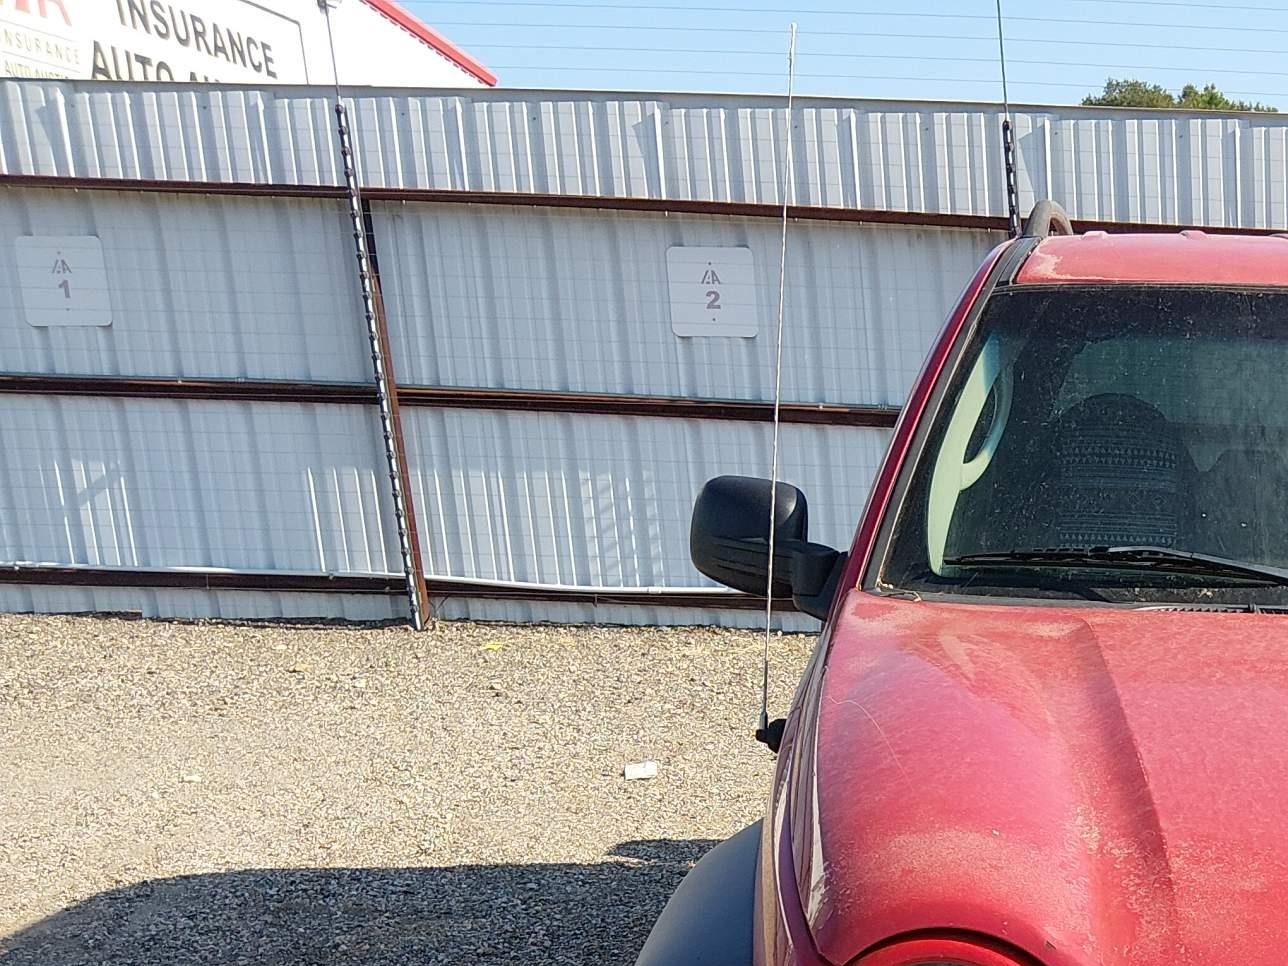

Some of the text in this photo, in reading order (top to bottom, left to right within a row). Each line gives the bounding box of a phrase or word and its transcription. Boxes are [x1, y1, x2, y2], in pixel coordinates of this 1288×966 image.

[114, 0, 278, 79] INSURANCE
[58, 279, 71, 299] 1
[705, 290, 722, 310] 2
